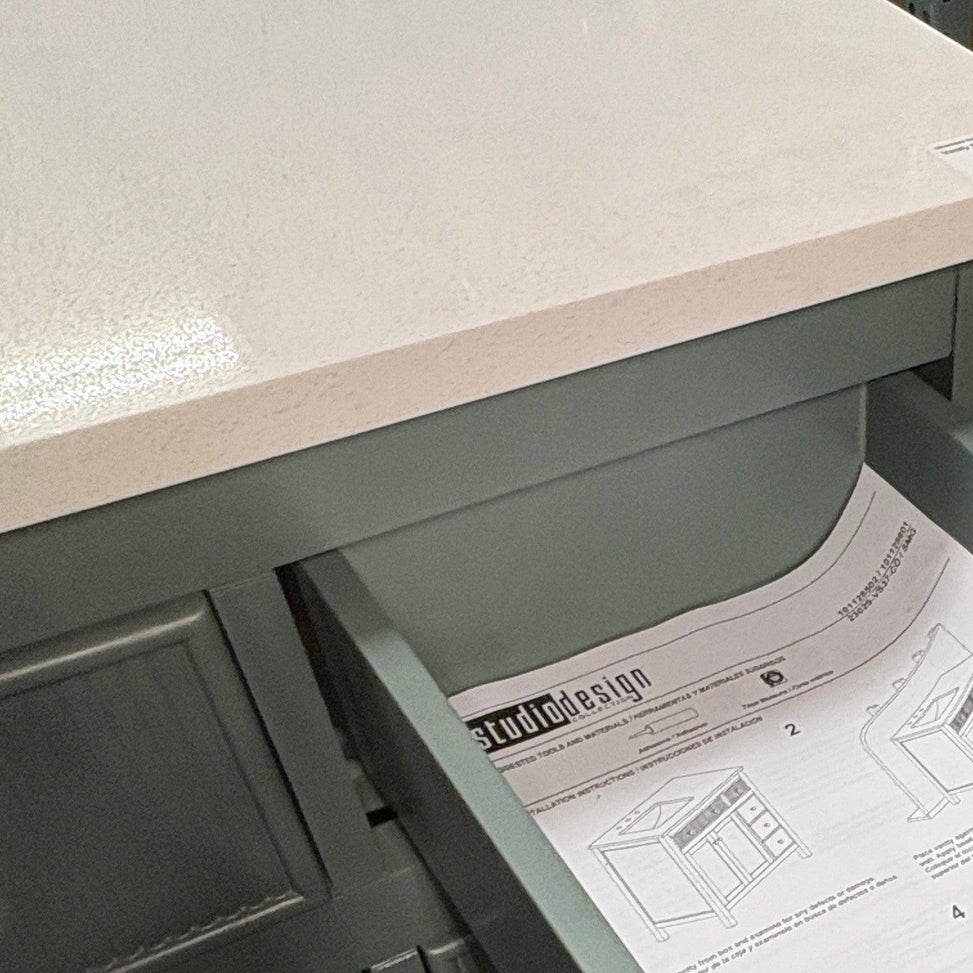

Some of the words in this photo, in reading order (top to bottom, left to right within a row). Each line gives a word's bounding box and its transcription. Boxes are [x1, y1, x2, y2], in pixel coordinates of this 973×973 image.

[784, 723, 801, 736] 2
[567, 737, 584, 747] AND
[952, 904, 966, 919] 4
[698, 954, 717, 966] from
[717, 946, 733, 956] box
[735, 937, 749, 947] and
[782, 916, 793, 924] for
